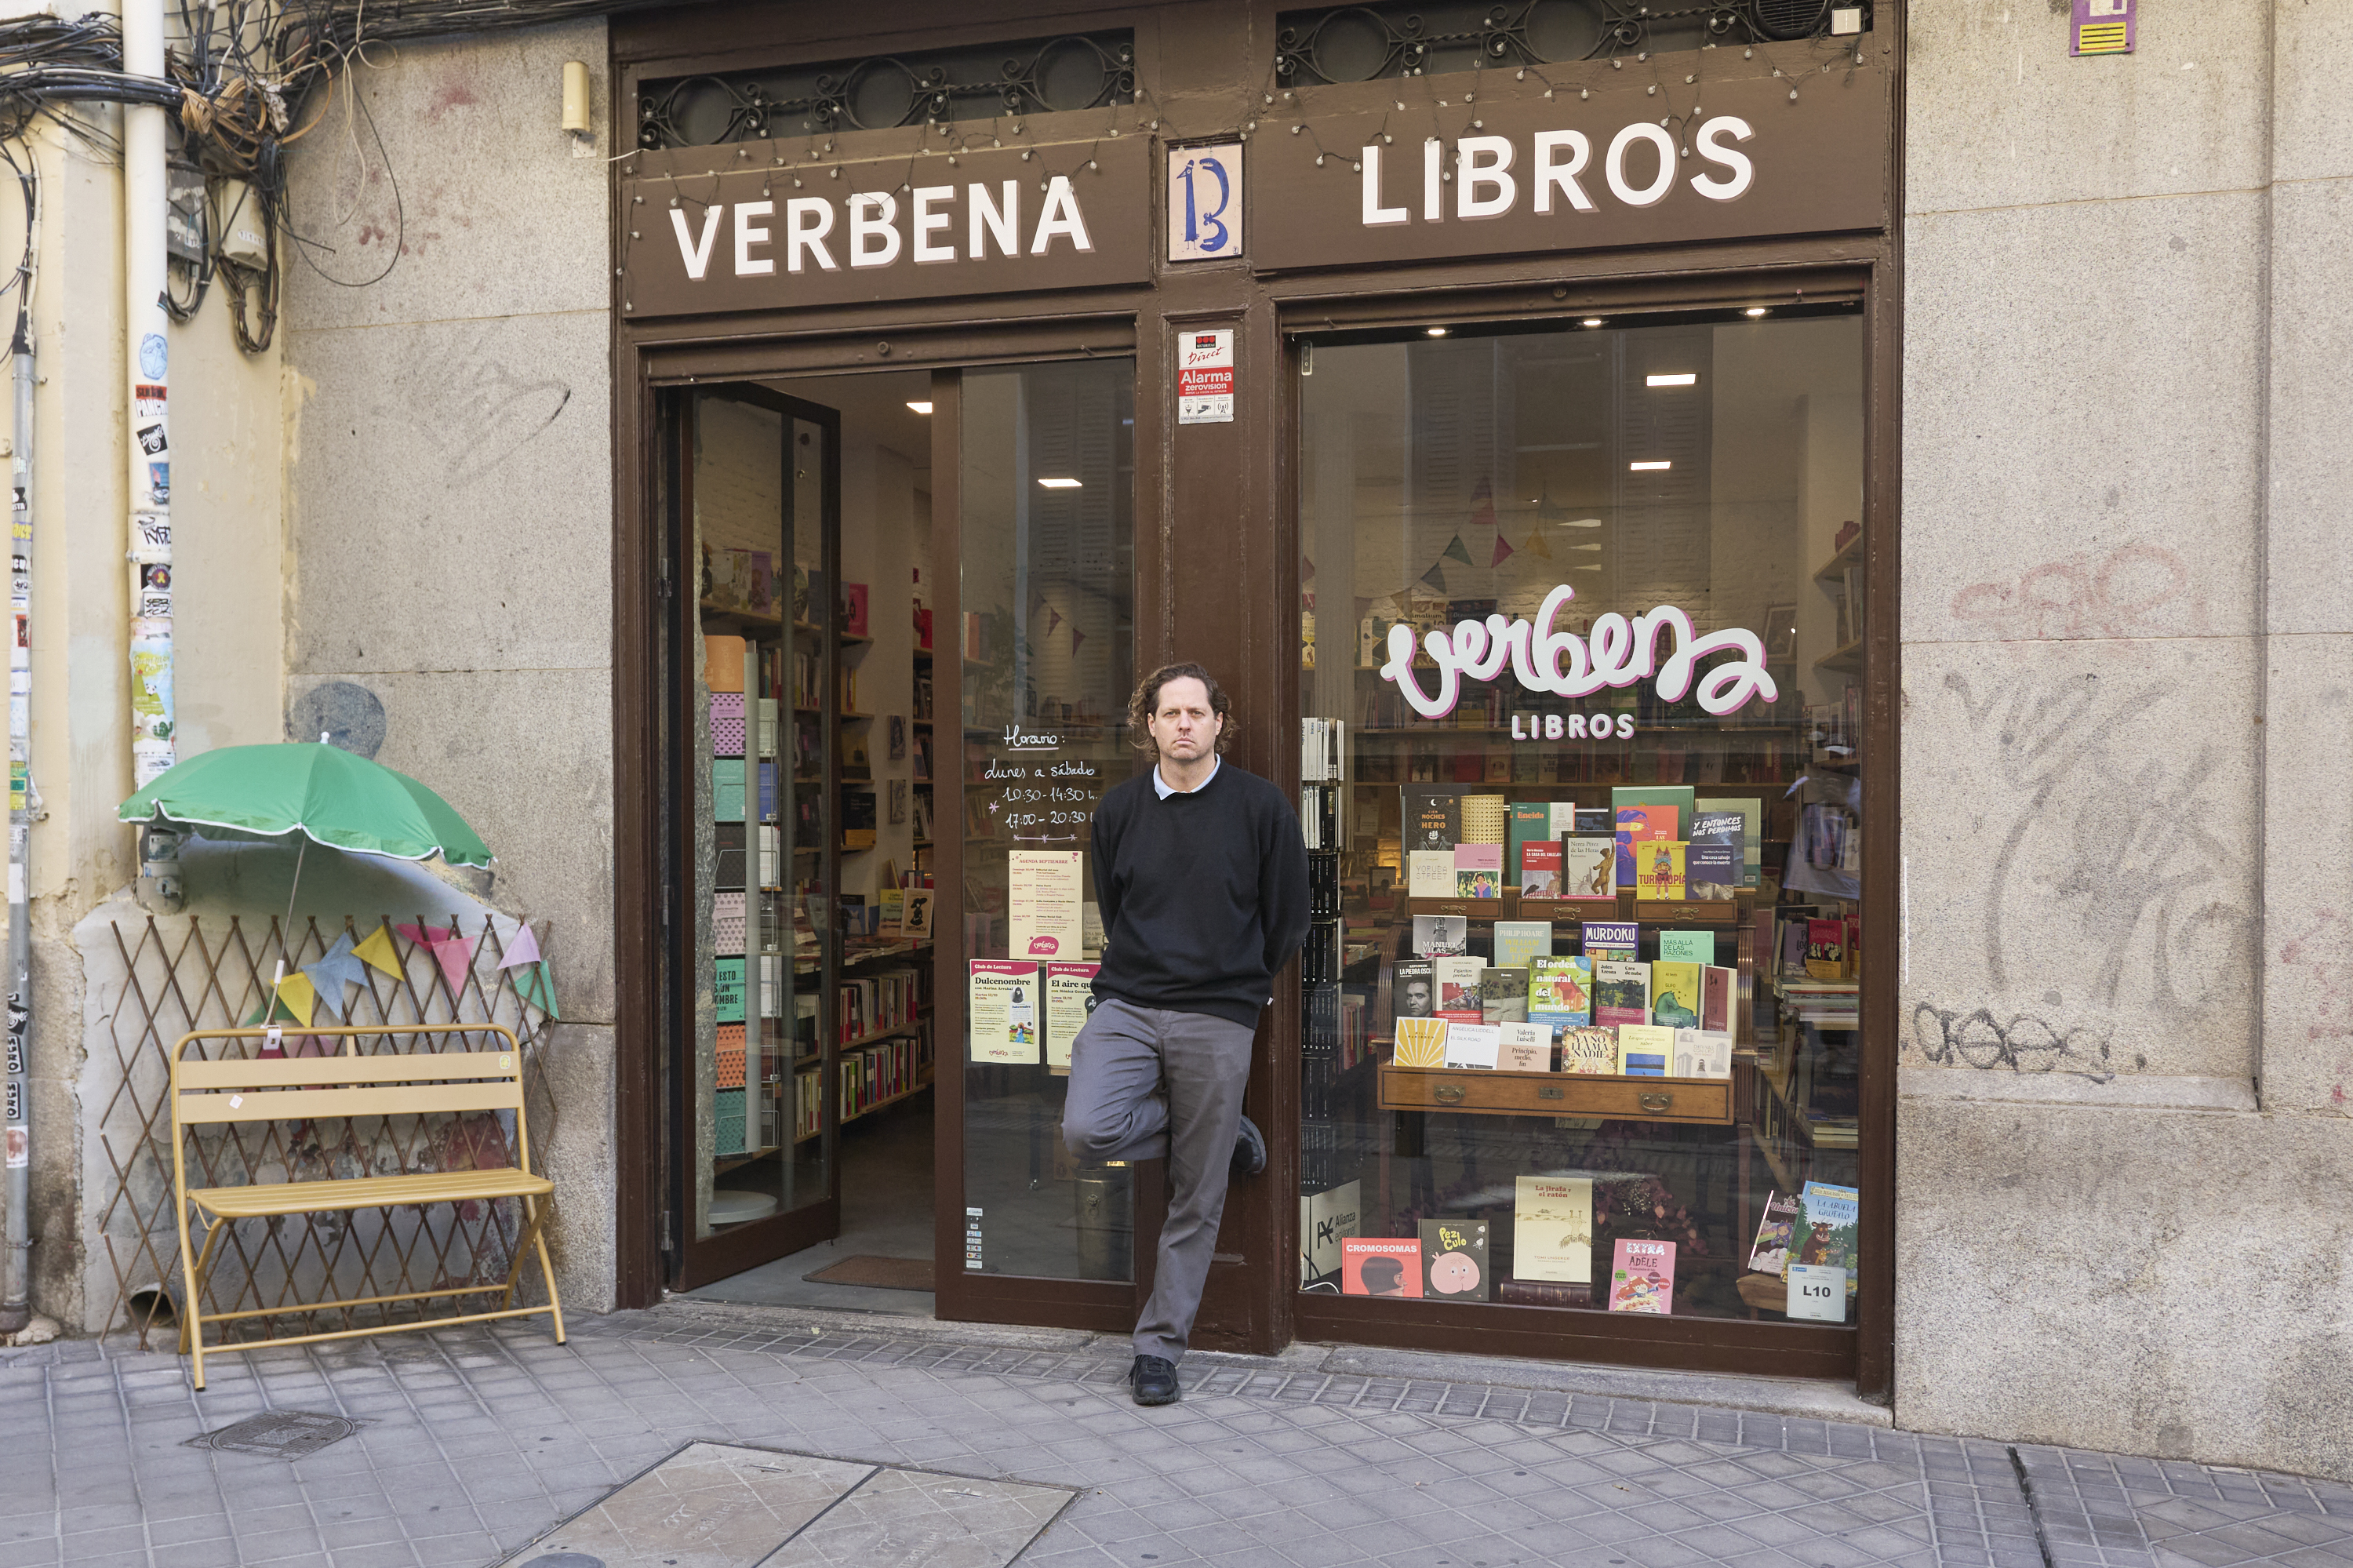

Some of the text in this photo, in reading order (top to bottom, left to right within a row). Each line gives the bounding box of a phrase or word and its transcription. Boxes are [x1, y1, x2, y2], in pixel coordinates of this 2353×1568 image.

[1362, 115, 1755, 227] LIBROS
[668, 176, 1093, 281] VERBENA
[1188, 347, 1225, 365] Direct
[1180, 370, 1232, 384] Alarma
[1380, 584, 1778, 719] verbena
[1511, 714, 1635, 740] LIBROS
[1004, 724, 1065, 747] Horario:
[1050, 761, 1094, 777] sábado
[1693, 824, 1741, 837] NOS PERDIMOS
[1694, 817, 1741, 830] Y ENTONCES
[1585, 926, 1635, 941] MURDOKU
[1537, 959, 1577, 969] El orden
[718, 970, 736, 980] ESTO
[1535, 988, 1551, 997] del
[1534, 1002, 1569, 1011] mundo
[1571, 1042, 1608, 1051] LLAMA
[1817, 1199, 1856, 1213] LA ABUELA
[1335, 1211, 1355, 1228] Alianza
[1335, 1224, 1355, 1242] editorial
[1439, 1227, 1457, 1241] Pez
[1444, 1232, 1467, 1250] Culo
[1346, 1244, 1417, 1253] CROMOSOMAS
[1626, 1242, 1665, 1256] EXTRA
[1803, 1286, 1831, 1297] L10
